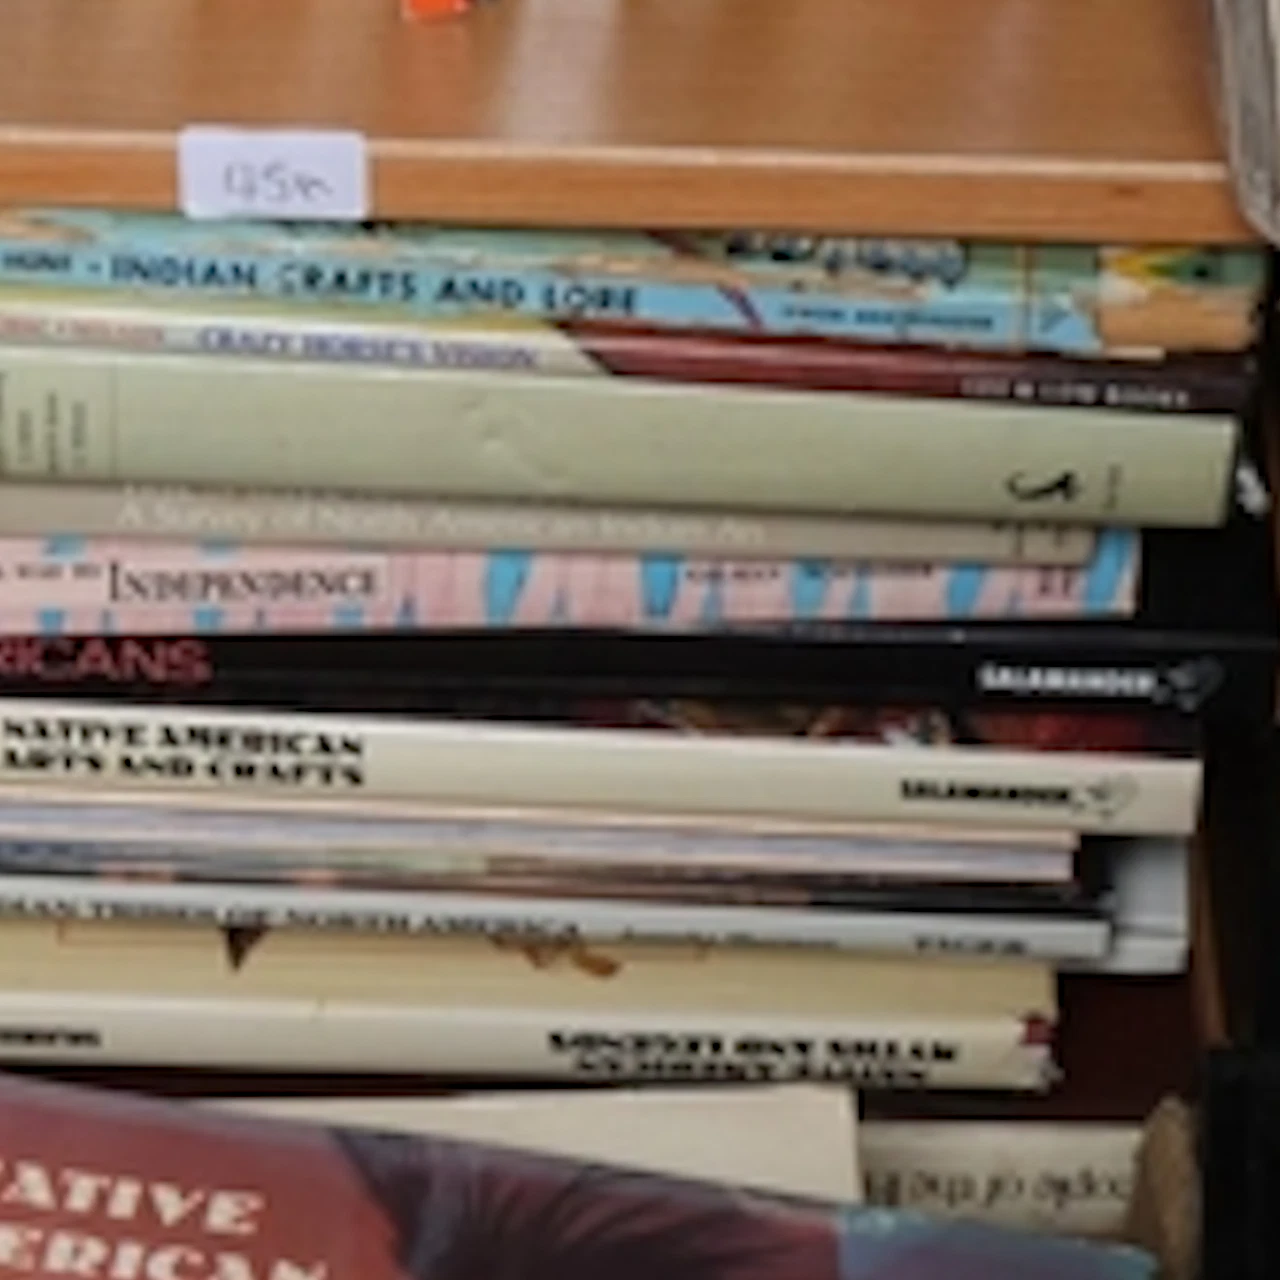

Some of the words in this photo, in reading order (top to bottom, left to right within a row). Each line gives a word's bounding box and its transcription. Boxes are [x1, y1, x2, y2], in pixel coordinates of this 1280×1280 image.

[108, 252, 258, 295] INDIAN
[279, 262, 418, 304] CRAFTS
[434, 273, 526, 311] AND
[542, 283, 638, 317] LORE
[157, 505, 259, 534] Survey
[321, 506, 421, 536] North
[429, 508, 592, 541] American
[106, 559, 376, 603] INDEPENDENCE
[978, 664, 1158, 696] SALAMANDER
[1, 718, 152, 752] NATIVE
[154, 724, 365, 757] AMERICAN
[1, 747, 105, 775] ARTS
[119, 752, 199, 780] AND
[208, 755, 365, 788] CRAFTS
[899, 778, 1076, 806] SALAMANDER
[547, 1029, 725, 1056] LEGENDS
[734, 1034, 817, 1060] AND
[825, 1037, 963, 1064] MYTHS
